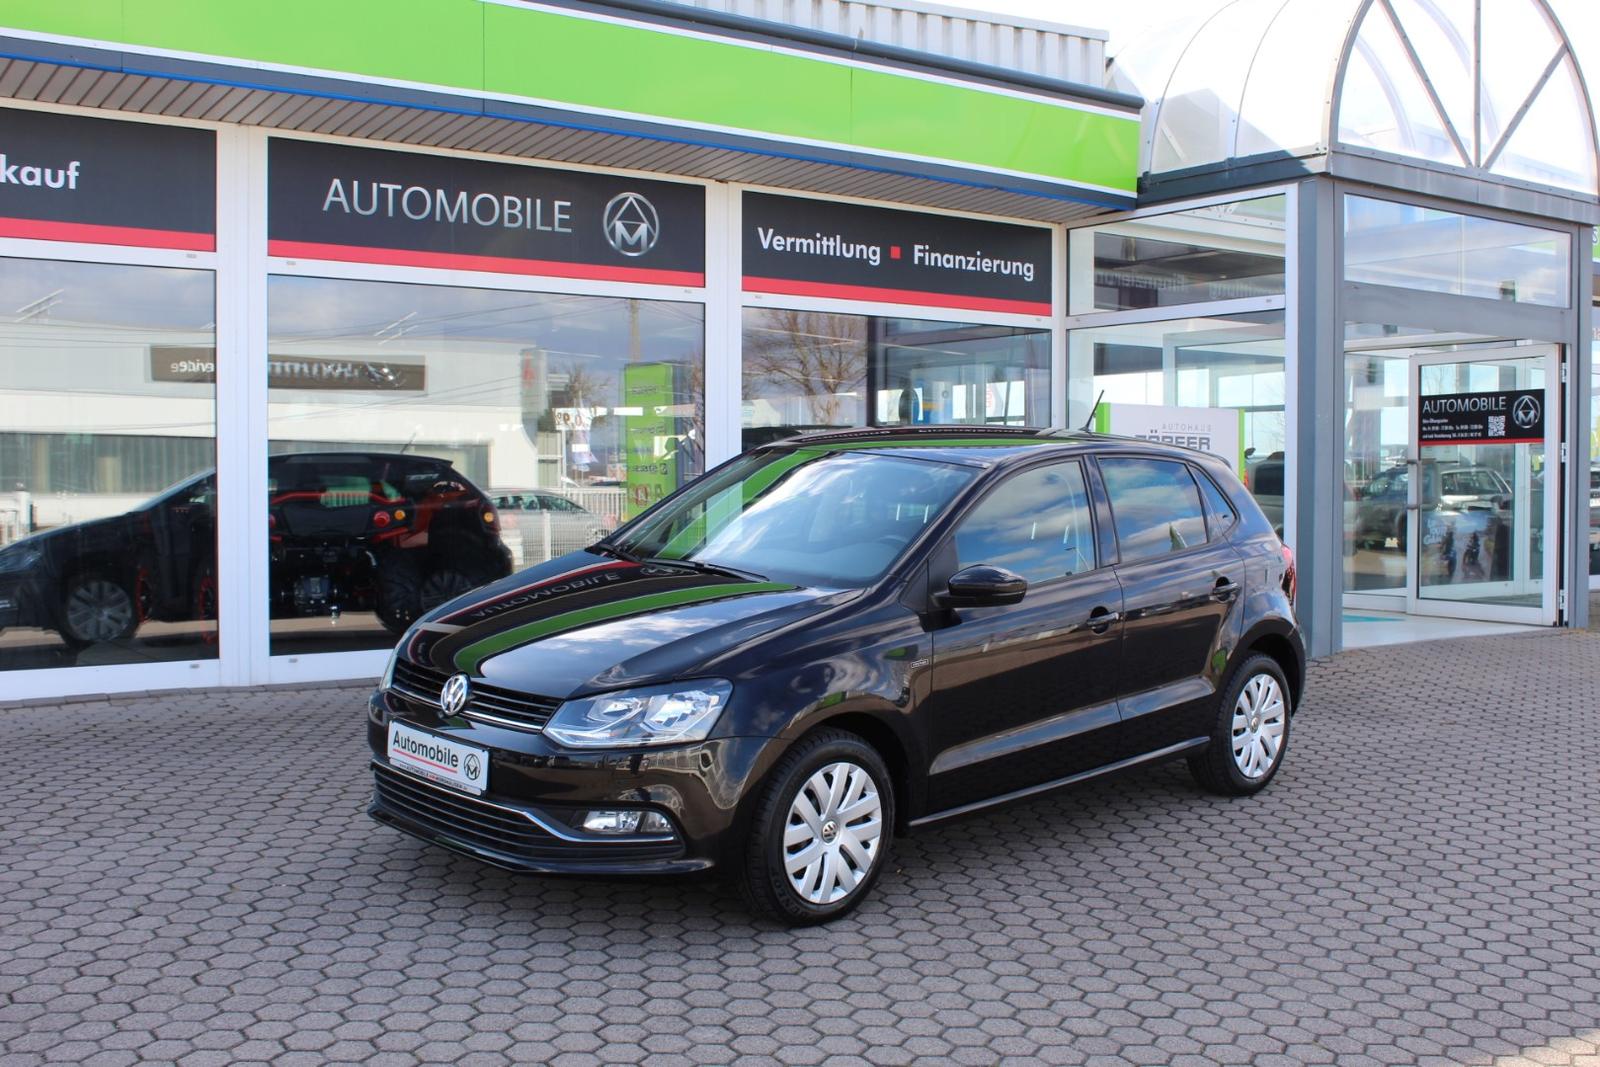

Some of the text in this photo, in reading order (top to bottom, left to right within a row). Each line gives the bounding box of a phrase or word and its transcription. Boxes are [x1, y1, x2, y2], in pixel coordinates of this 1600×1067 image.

[0, 153, 80, 189] kauf
[322, 178, 572, 233] AUTOMOBILE
[757, 227, 1034, 282] Vermittlung Finanzierung
[1422, 396, 1507, 414] AUTOMOBILE
[1162, 423, 1212, 433] AUTOHAUS
[392, 730, 459, 768] Automobile
